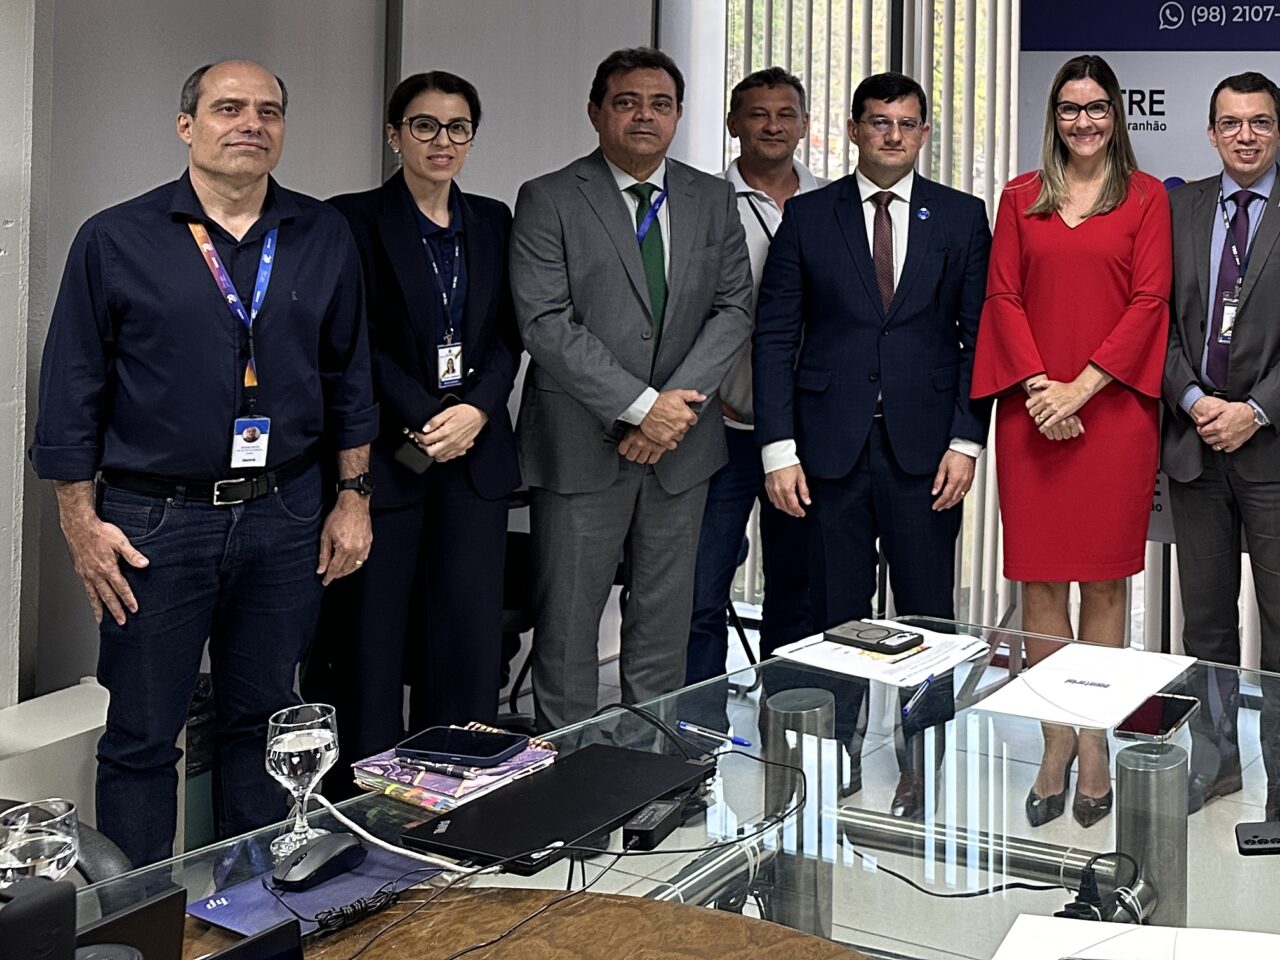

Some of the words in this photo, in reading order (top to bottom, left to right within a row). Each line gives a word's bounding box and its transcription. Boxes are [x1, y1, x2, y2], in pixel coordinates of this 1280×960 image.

[1191, 4, 1227, 26] (98)
[1121, 89, 1165, 116] RE
[1128, 120, 1167, 132] ranhão
